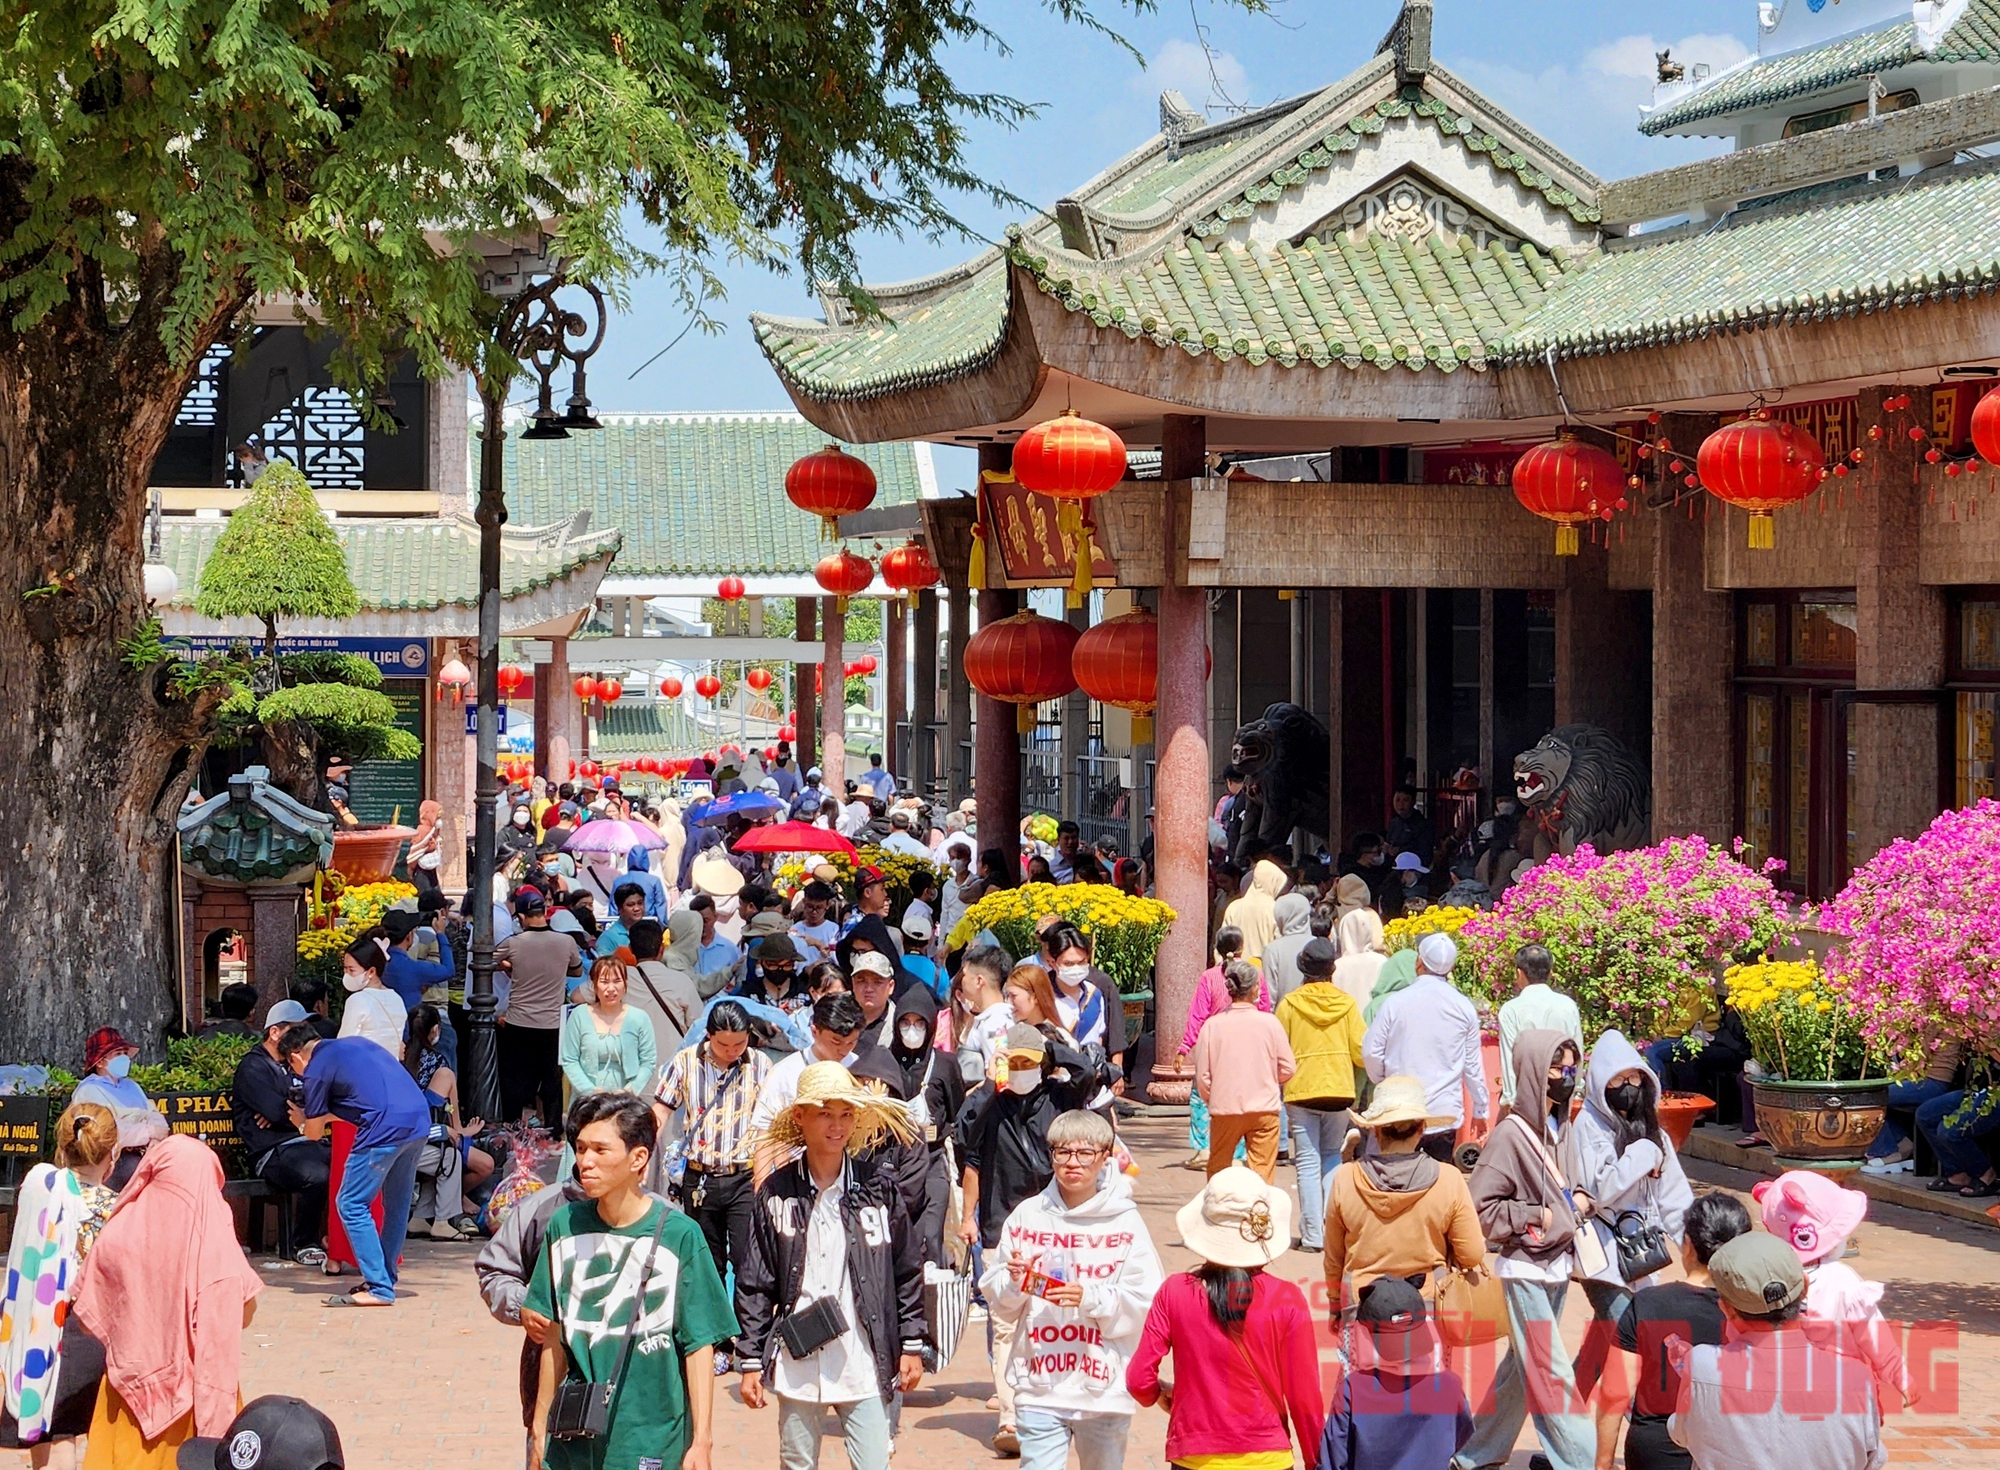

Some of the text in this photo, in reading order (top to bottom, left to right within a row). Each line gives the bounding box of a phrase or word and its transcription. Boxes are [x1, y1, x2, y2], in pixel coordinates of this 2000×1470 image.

[323, 639, 339, 647] SAM
[374, 650, 400, 665] LỊCH
[177, 1092, 234, 1114] PHÁ
[172, 1119, 234, 1134] KINH DOANH
